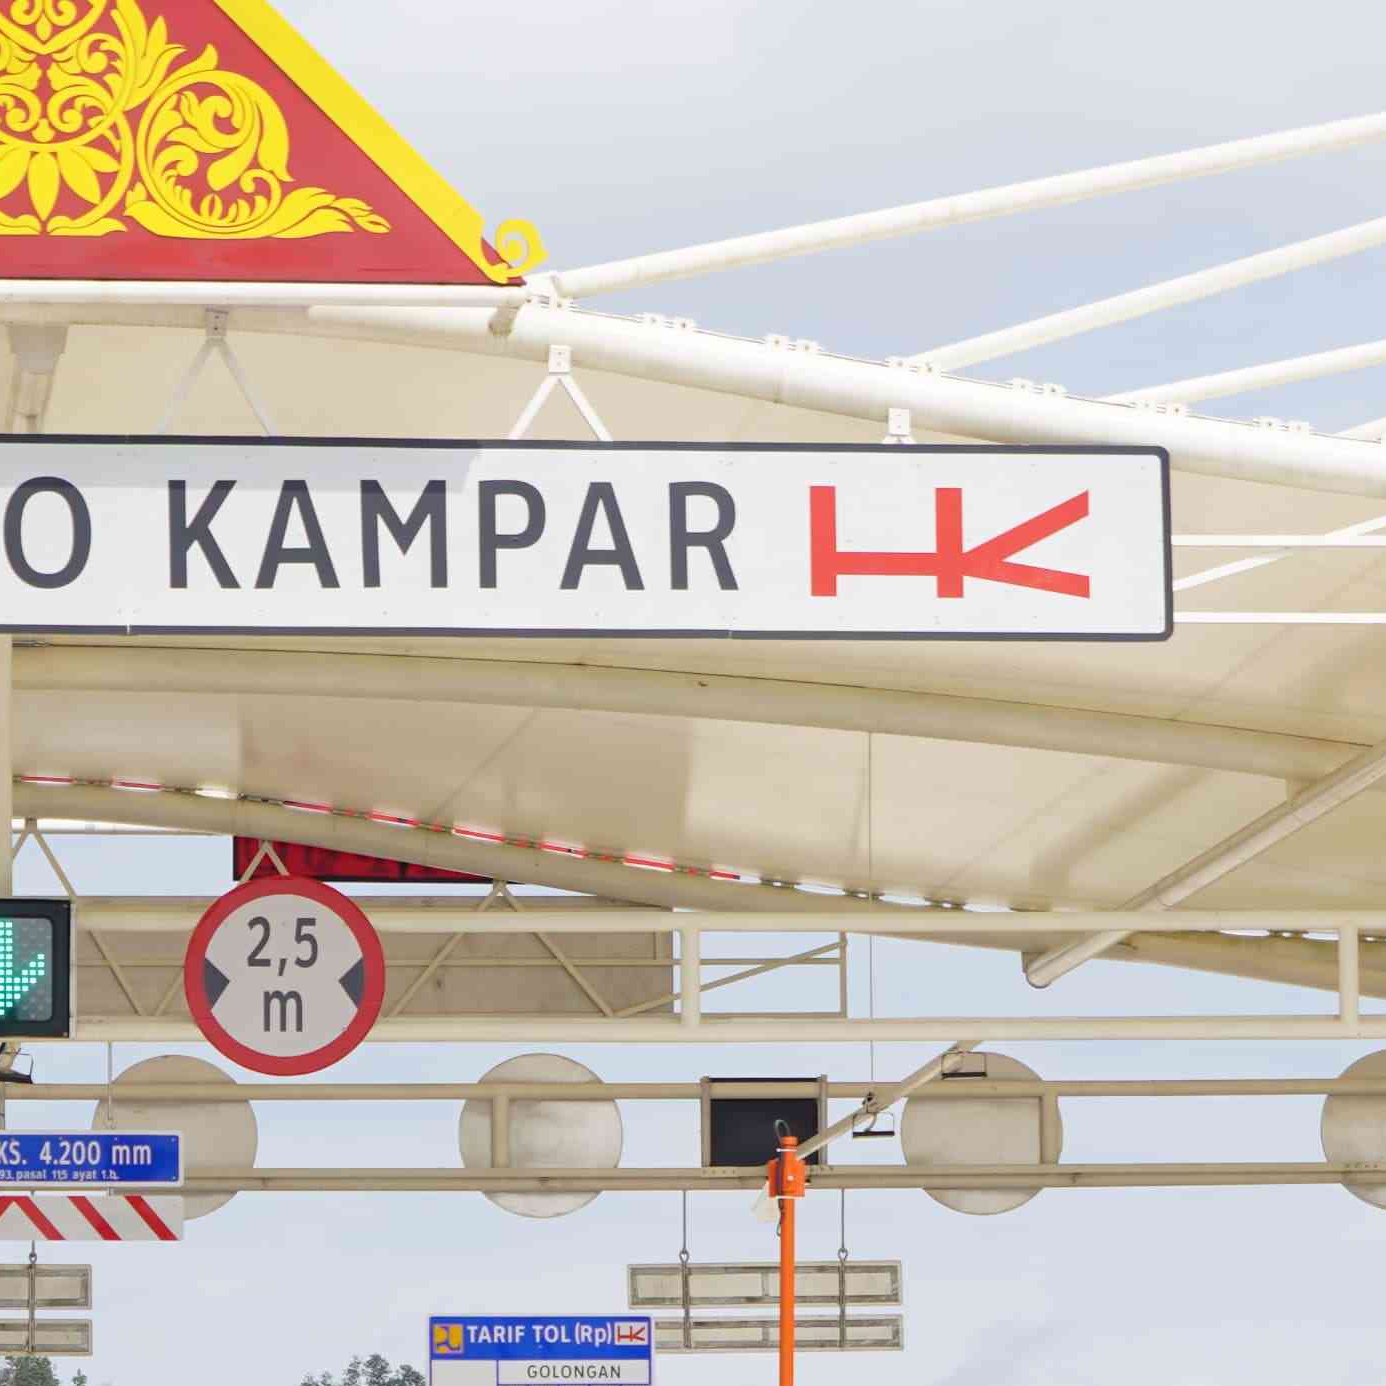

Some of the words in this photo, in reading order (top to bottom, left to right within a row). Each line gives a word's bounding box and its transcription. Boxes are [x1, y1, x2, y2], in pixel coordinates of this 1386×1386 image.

[168, 477, 738, 590] KAMPAR
[246, 916, 319, 976] 2,5
[263, 988, 304, 1032] m
[39, 1140, 101, 1165] 4.200
[112, 1145, 152, 1165] mm
[72, 1169, 96, 1182] ayat
[467, 1325, 525, 1343] TARIF
[532, 1325, 571, 1343] TOL
[575, 1322, 612, 1348] (Rp)
[527, 1365, 621, 1379] GOLONGAN
